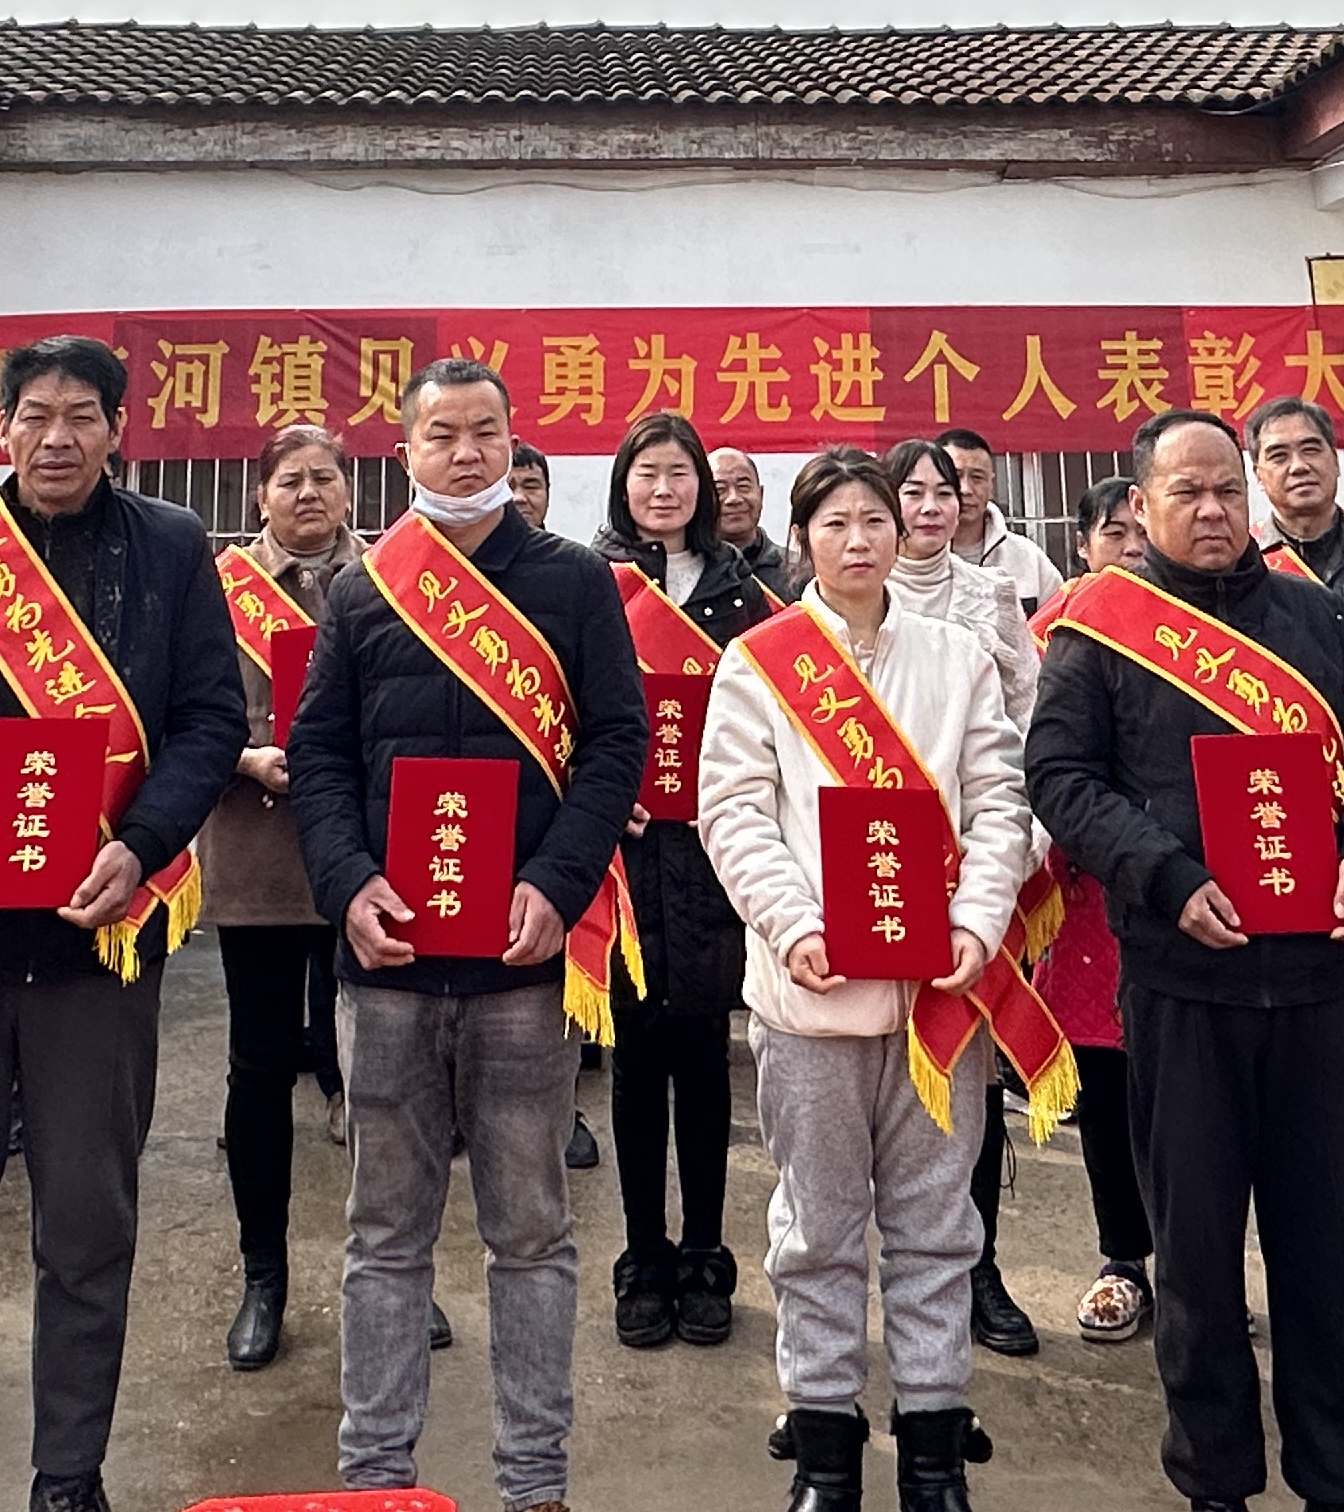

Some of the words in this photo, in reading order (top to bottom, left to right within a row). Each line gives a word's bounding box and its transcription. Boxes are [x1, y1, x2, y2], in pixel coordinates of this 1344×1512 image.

[655, 699, 684, 794] 荣誉证书
[9, 750, 58, 872] 荣誉证书
[426, 791, 468, 918] 荣誉证书
[1247, 768, 1296, 896] 荣誉证书
[866, 820, 906, 943] 荣誉证书
